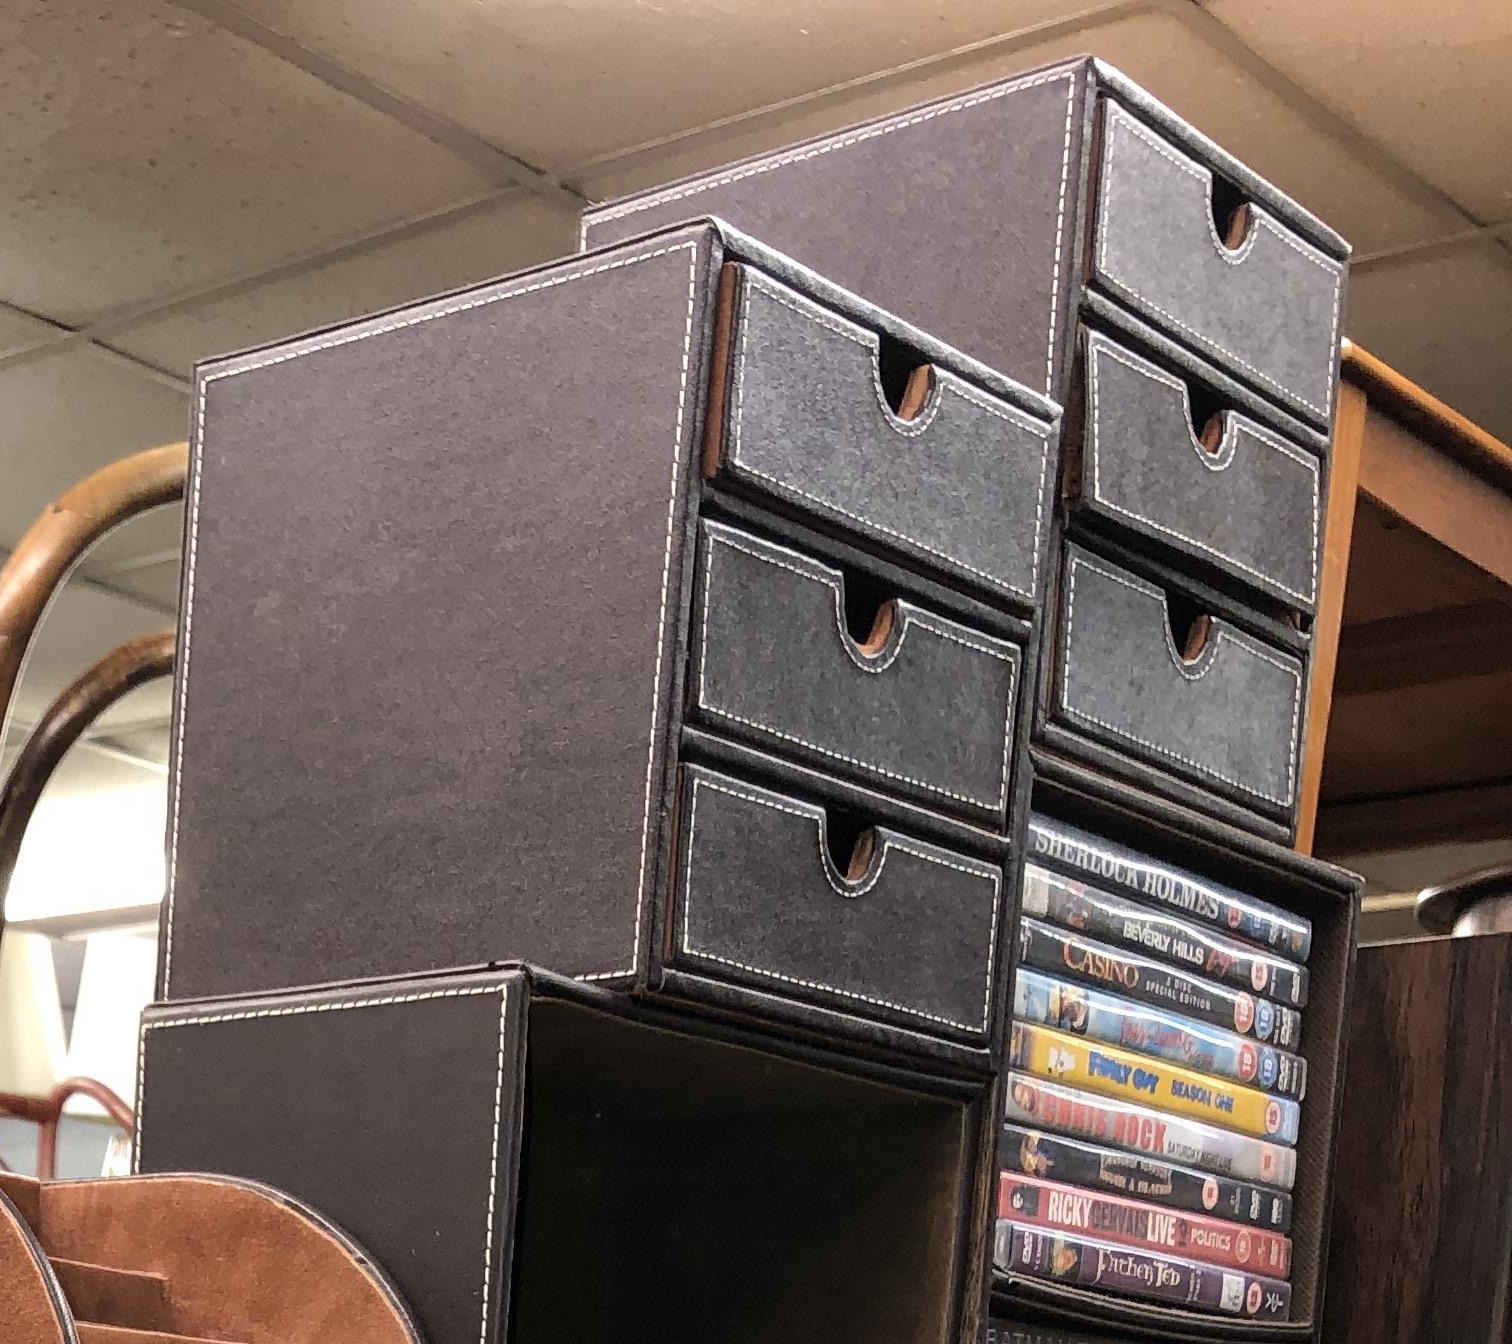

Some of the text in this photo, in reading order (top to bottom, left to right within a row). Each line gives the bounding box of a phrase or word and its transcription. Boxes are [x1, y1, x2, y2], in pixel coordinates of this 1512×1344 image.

[1035, 833, 1220, 920] SHERLOCK HOLMES
[1062, 934, 1140, 988] CASINO
[1122, 921, 1205, 966] BEVERLY HILLS
[1048, 1189, 1093, 1229] RICKY
[1146, 1212, 1177, 1247] LIVE
[1190, 1228, 1232, 1251] POLITICS
